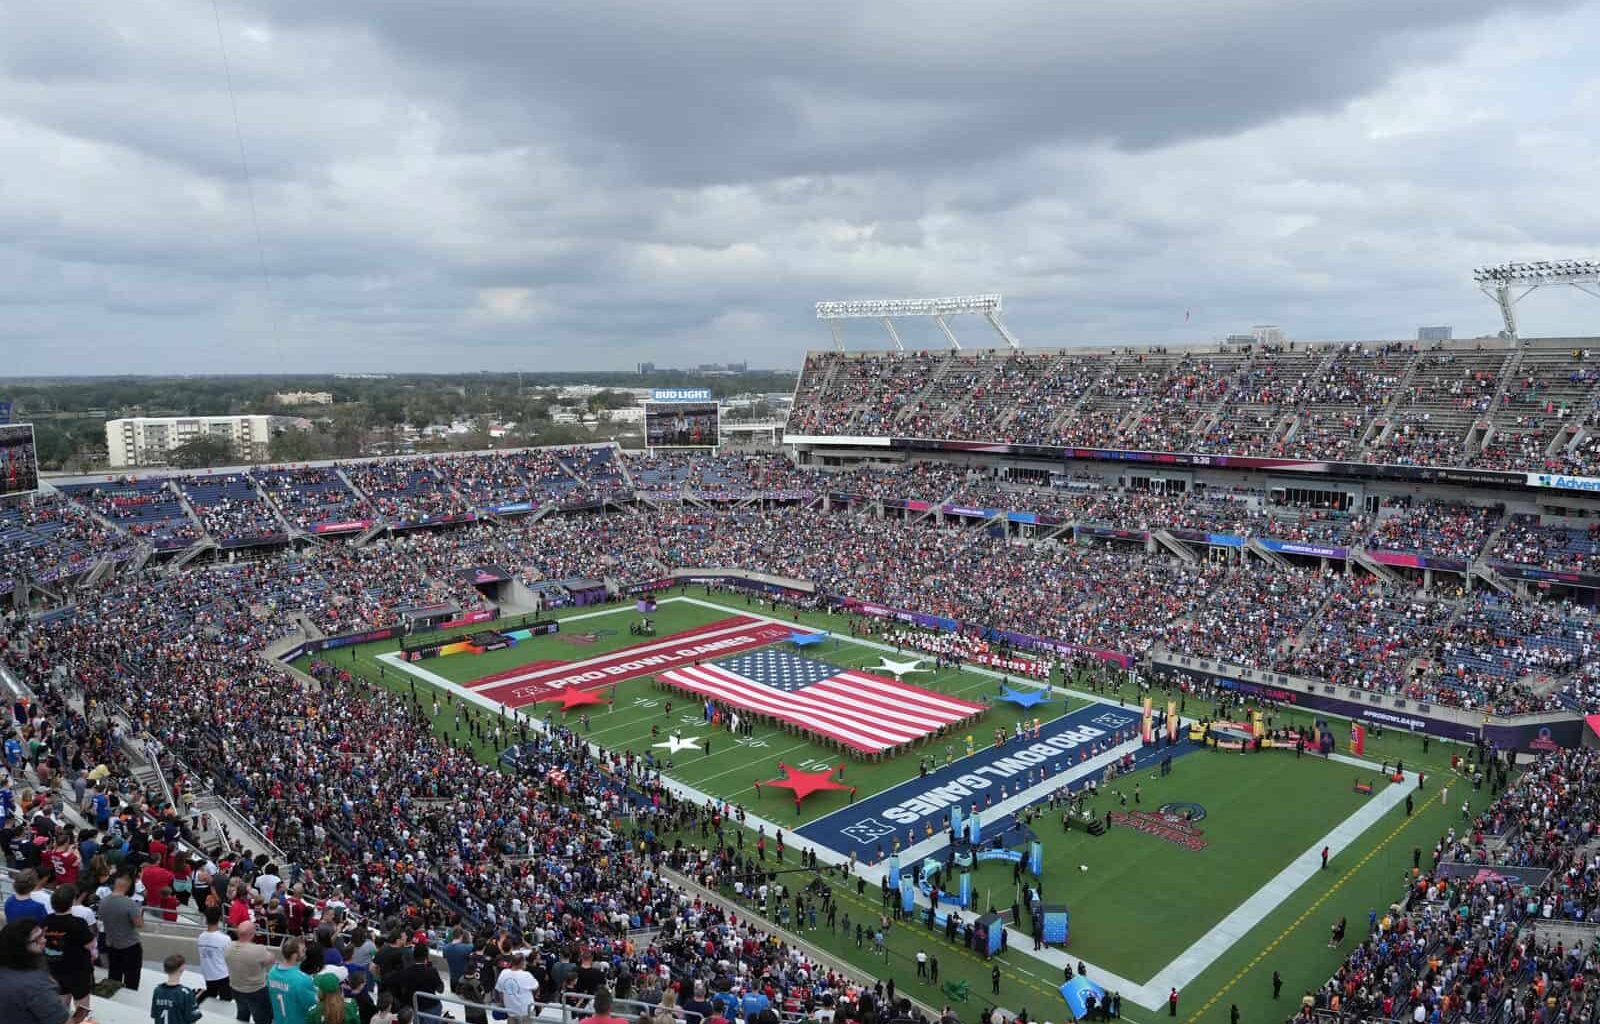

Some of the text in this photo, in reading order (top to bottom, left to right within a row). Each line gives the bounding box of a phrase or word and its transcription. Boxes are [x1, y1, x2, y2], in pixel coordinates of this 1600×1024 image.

[655, 390, 708, 399] BUD LIGHT
[602, 653, 683, 675] BOWL
[676, 635, 757, 657] GAMES
[799, 759, 829, 771] 10
[973, 743, 1065, 778] BOWL
[881, 774, 993, 825] GAMES
[277, 993, 287, 1017] 1
